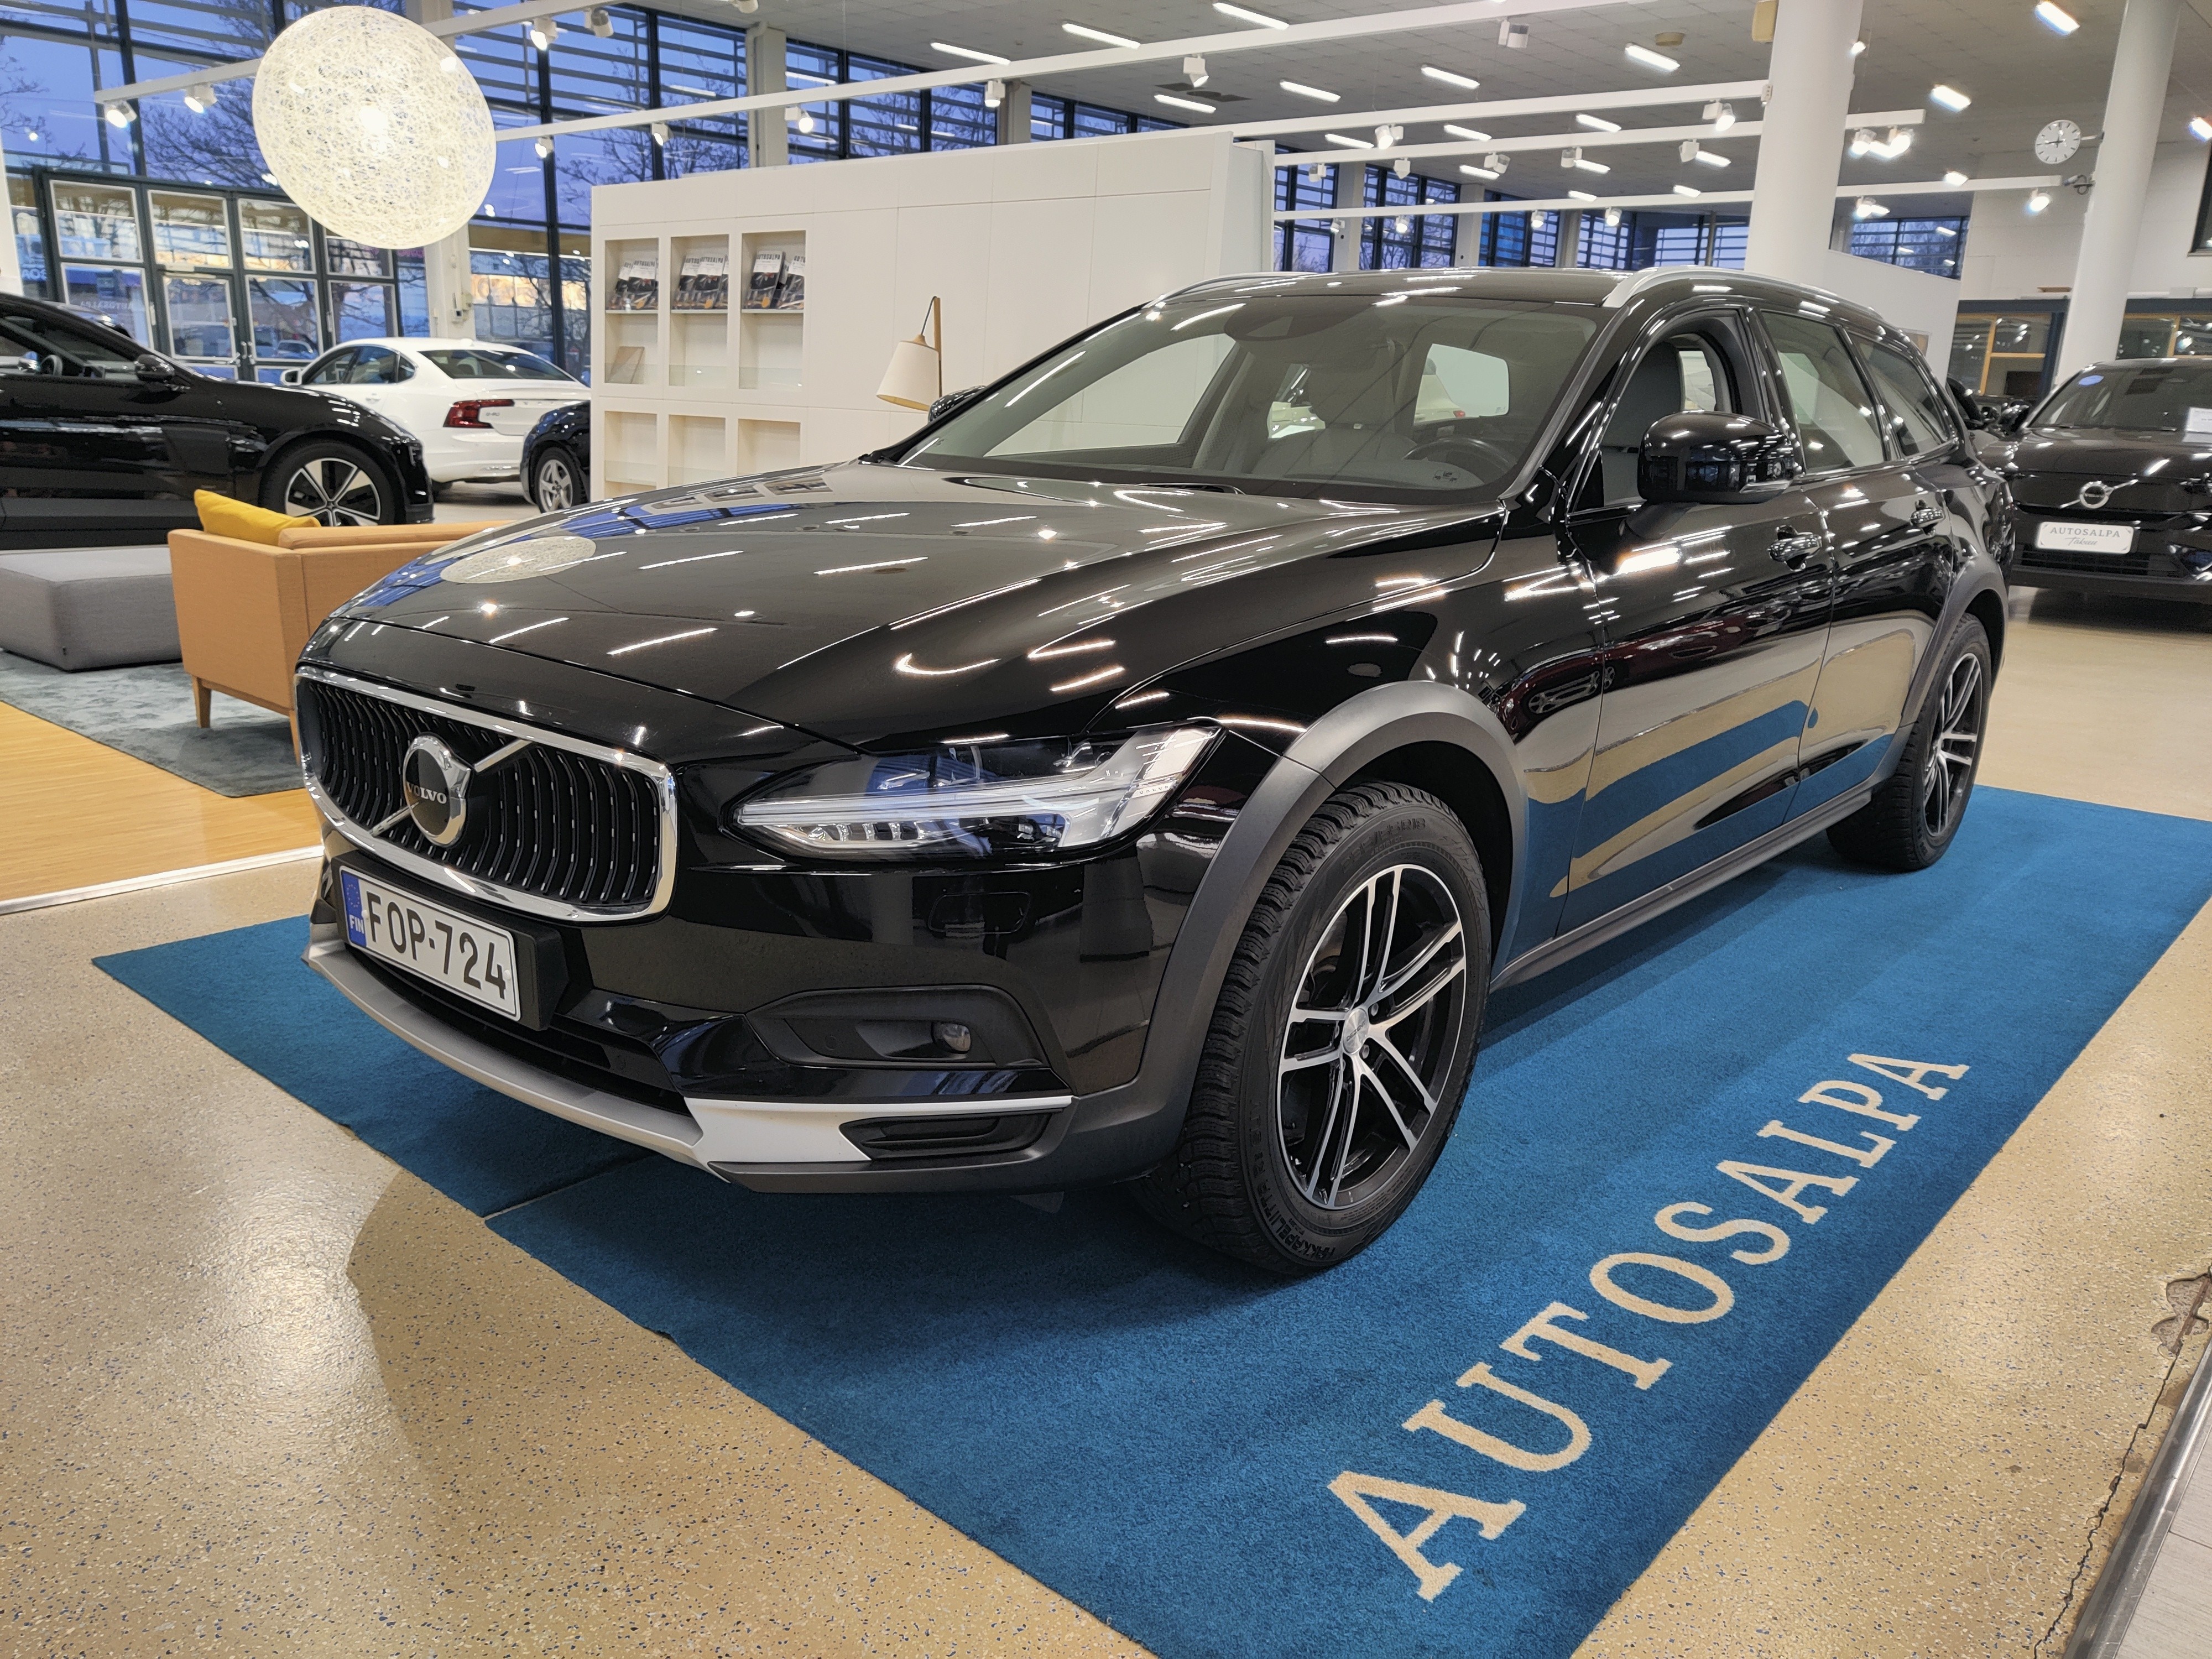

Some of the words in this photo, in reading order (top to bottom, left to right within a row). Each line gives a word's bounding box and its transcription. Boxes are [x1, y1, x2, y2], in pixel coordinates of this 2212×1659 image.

[2049, 526, 2120, 538] AUTOSALPA
[405, 781, 447, 805] VOLVO
[349, 915, 365, 934] FIN
[366, 890, 506, 1000] FOP-724
[1327, 1053, 1970, 1602] AUTOSALPA
